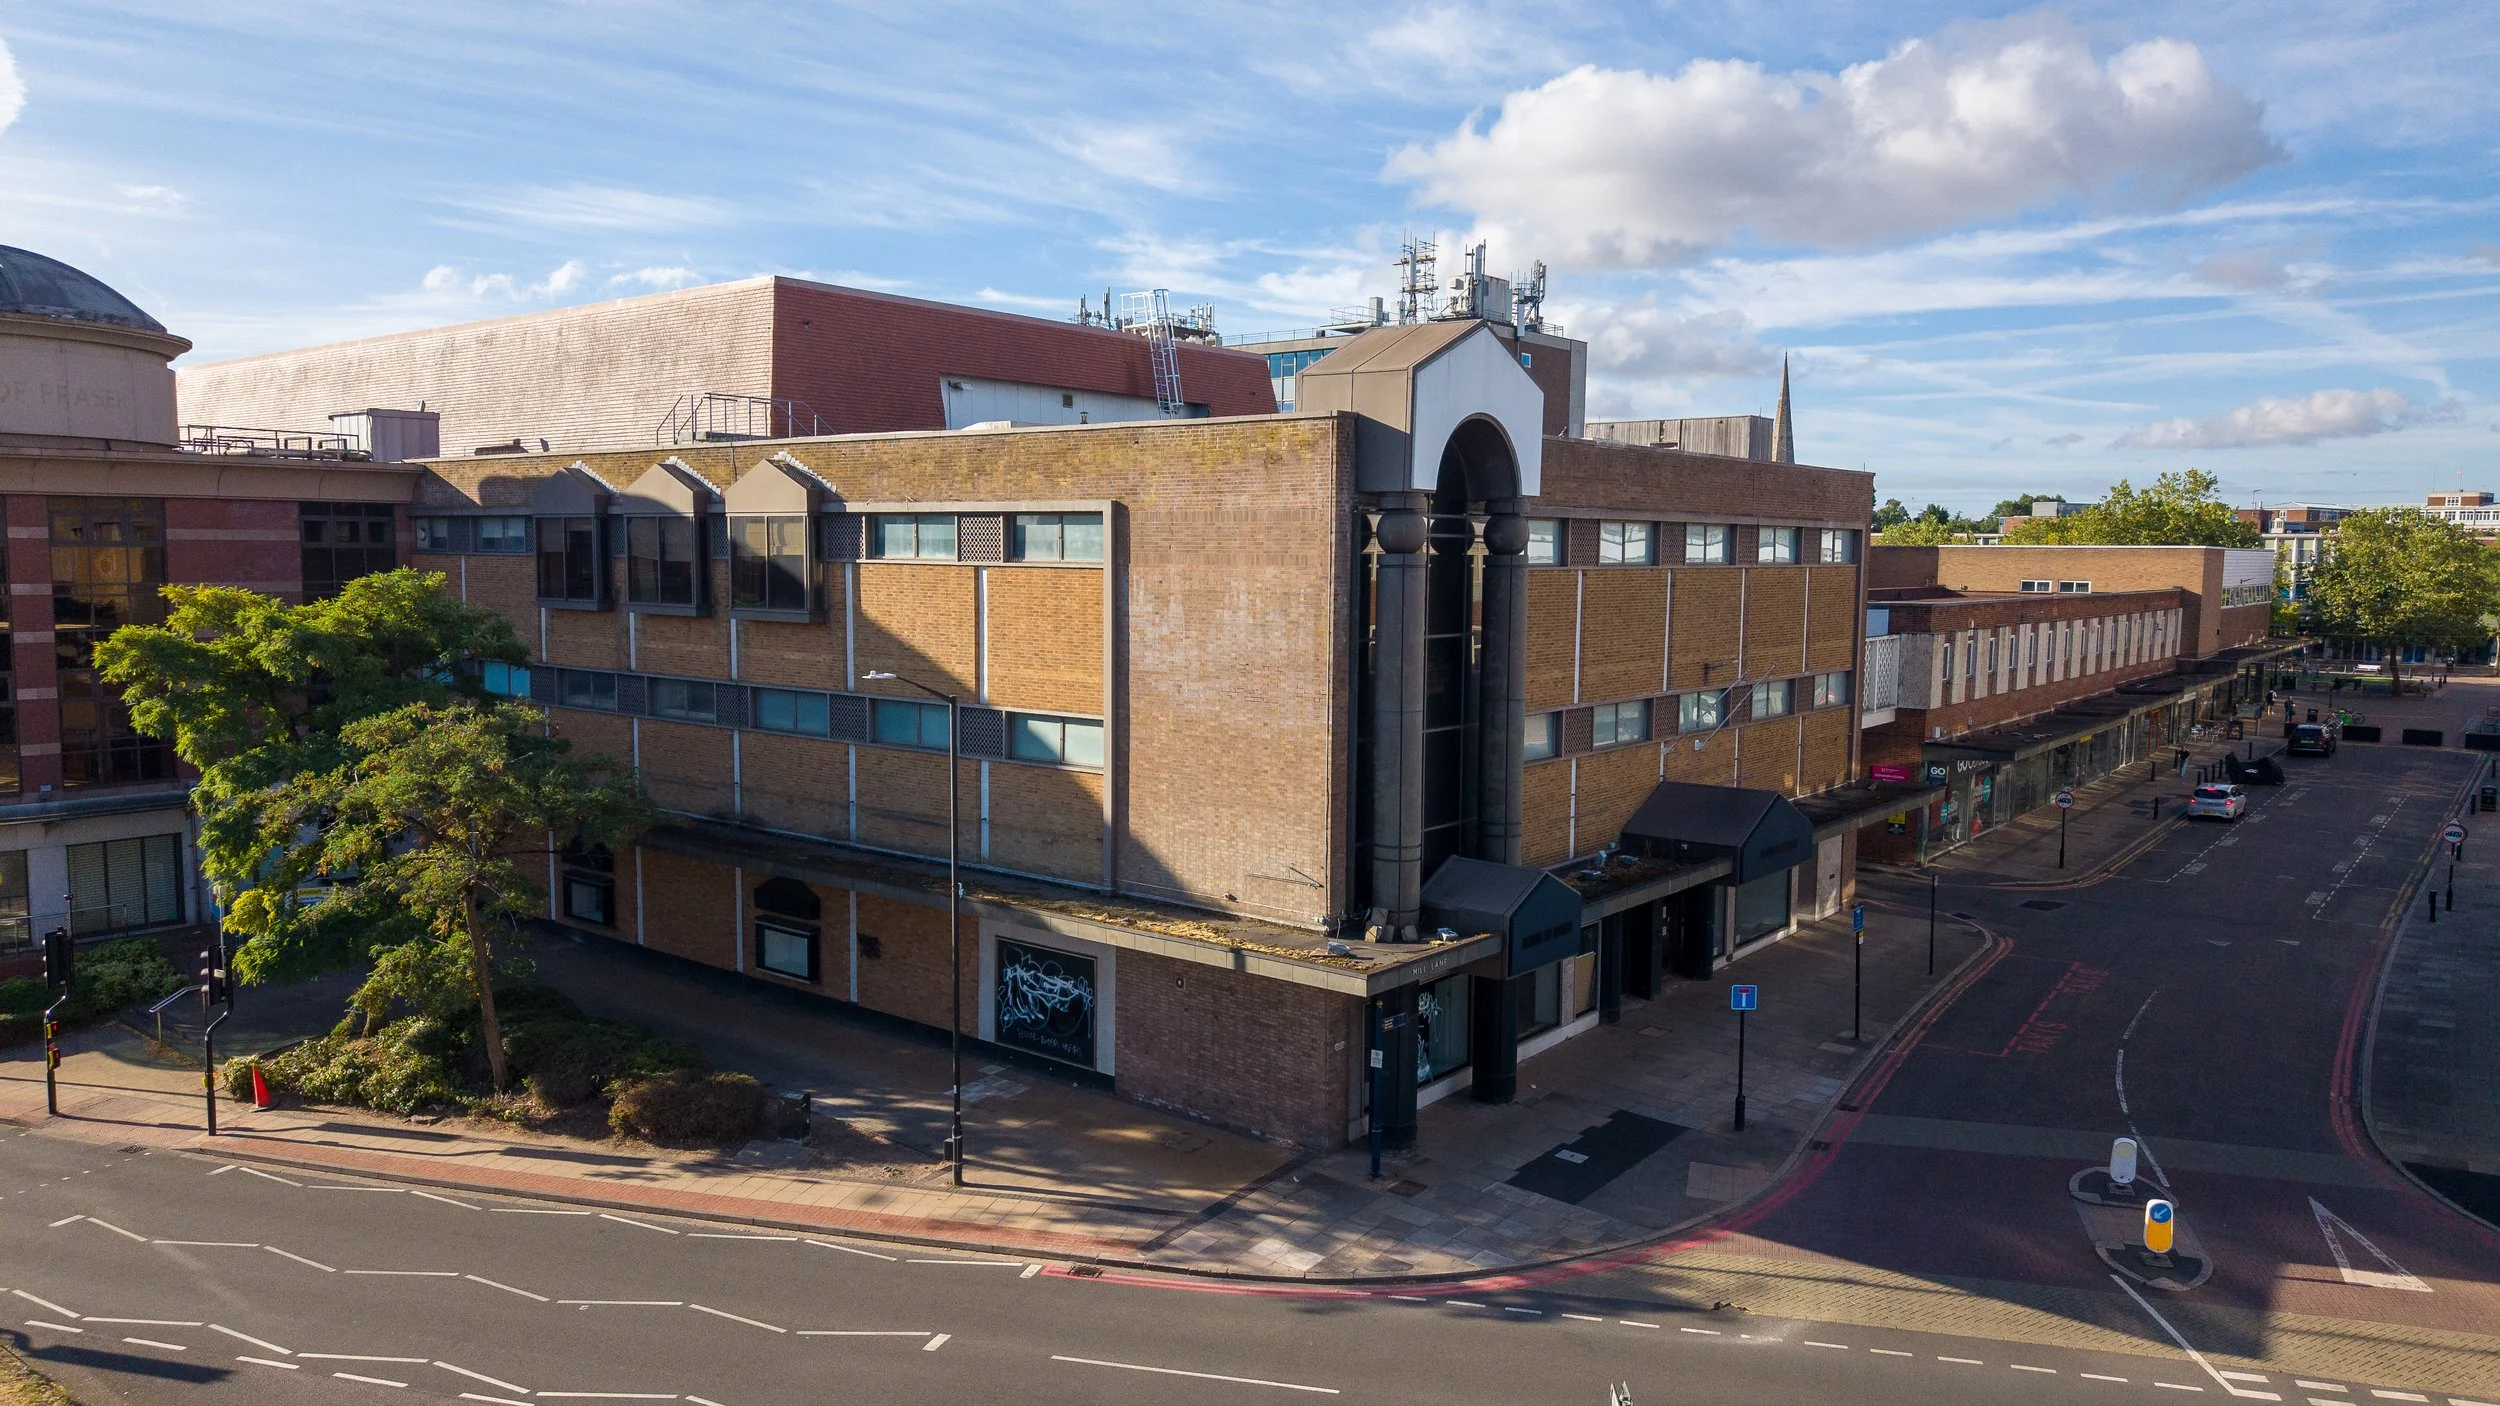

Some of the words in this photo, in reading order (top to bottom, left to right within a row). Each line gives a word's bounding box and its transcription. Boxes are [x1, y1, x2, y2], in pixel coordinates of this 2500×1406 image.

[40, 382, 128, 410] FRASER
[1930, 766, 1946, 775] GO
[1412, 966, 1426, 976] MILL
[1431, 958, 1447, 970] LANE
[2017, 1021, 2067, 1054] TAXIS
